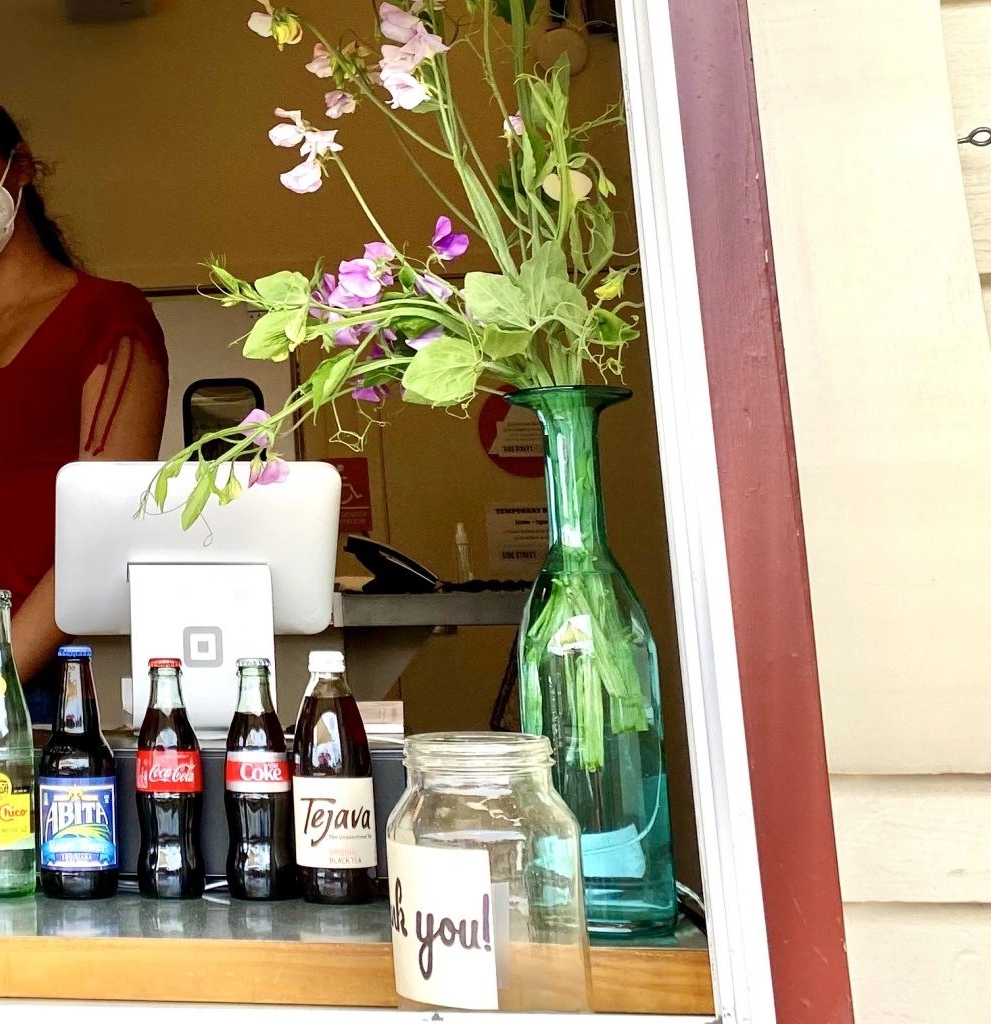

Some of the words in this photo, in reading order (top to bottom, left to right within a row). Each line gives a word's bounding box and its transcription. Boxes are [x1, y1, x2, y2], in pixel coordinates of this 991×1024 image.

[240, 762, 283, 782] Coke
[46, 801, 109, 839] ABITA
[300, 798, 371, 847] Tejava
[329, 856, 350, 864] BLACK
[351, 856, 362, 864] TEA
[415, 893, 492, 981] you!
